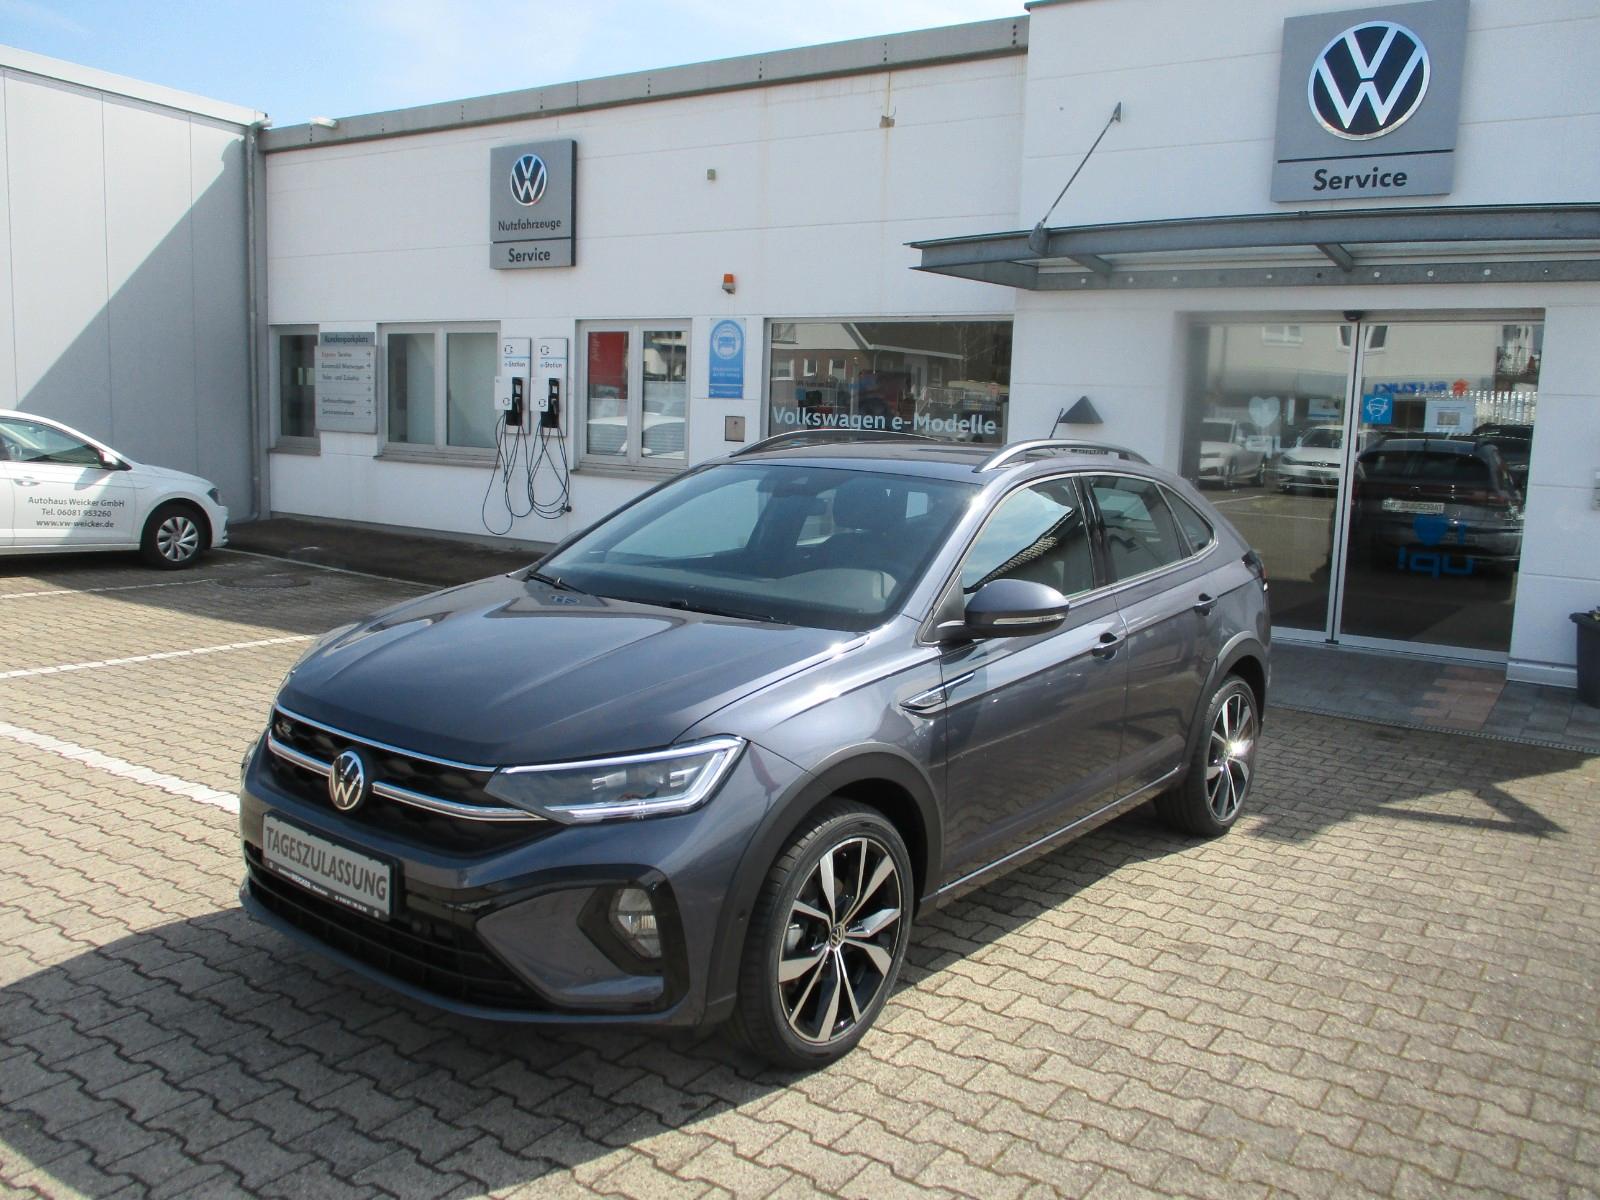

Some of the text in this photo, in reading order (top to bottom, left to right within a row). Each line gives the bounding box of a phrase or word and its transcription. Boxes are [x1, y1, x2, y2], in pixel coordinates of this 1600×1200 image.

[1308, 21, 1430, 140] VW
[510, 154, 547, 206] VW
[1313, 166, 1408, 191] Service
[498, 219, 562, 231] Nutzfahrzeuge
[508, 248, 551, 263] Service
[772, 406, 997, 435] Volkswagen e-Modelle
[28, 496, 125, 508] Autohaus Weicker GmbH
[42, 508, 112, 518] Tel. 06081 953260
[36, 519, 115, 528] www.vw-weicker.de
[265, 826, 388, 901] TAGESZULASSUNG
